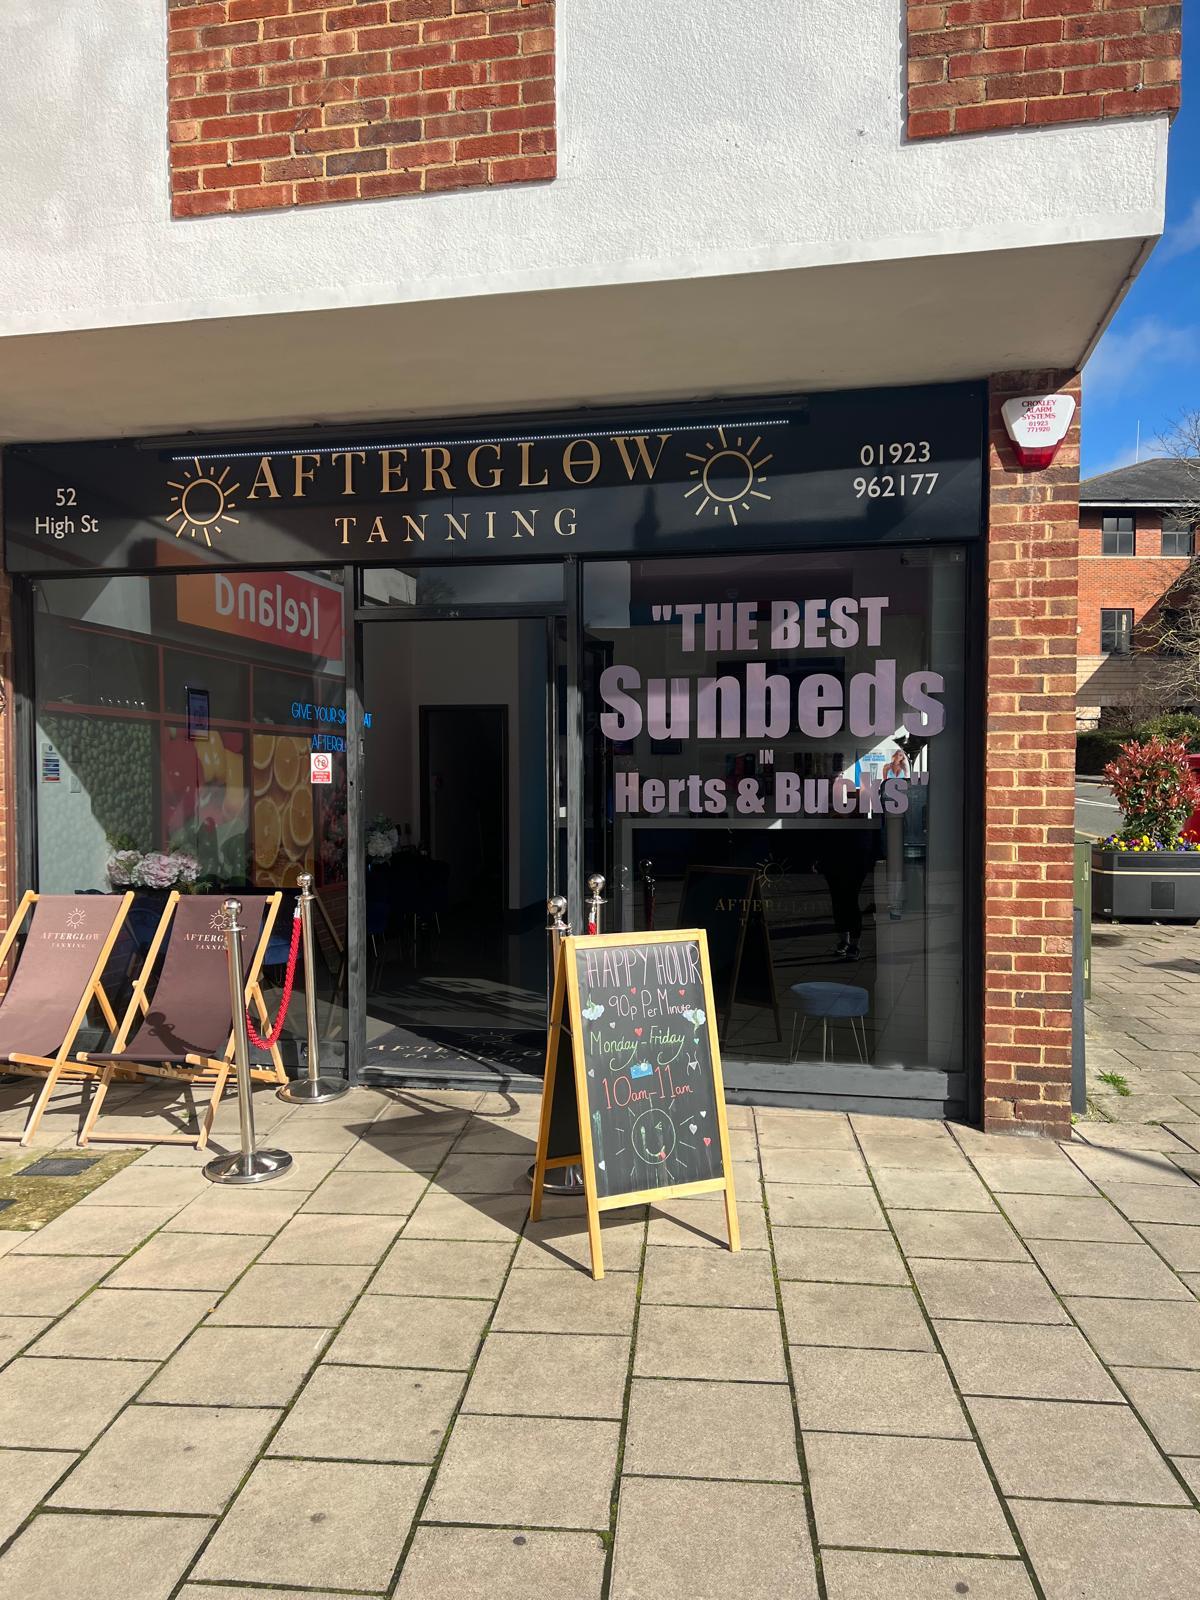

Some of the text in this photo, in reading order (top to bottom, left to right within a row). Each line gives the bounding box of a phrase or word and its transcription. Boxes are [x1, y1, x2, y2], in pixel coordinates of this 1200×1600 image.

[860, 441, 931, 466] 01923
[246, 434, 673, 499] AFTERGLOW
[55, 487, 77, 506] 52
[853, 473, 939, 498] 962177
[35, 514, 99, 539] High St
[334, 508, 577, 544] TANNING
[652, 597, 889, 652] "THE BEST
[291, 702, 312, 720] GIVE
[314, 705, 337, 722] YOUR
[600, 659, 945, 740] Sunbeds
[311, 734, 347, 752] AFTERGL
[759, 749, 774, 764] IN
[615, 773, 727, 813] Herts
[736, 778, 765, 813] &
[40, 932, 101, 941] AFTERGLOW
[184, 933, 247, 942] AFTERG
[586, 943, 703, 988] HAPPY HOUR
[608, 988, 692, 1021] 90p Per Minute
[590, 1030, 639, 1071] Monday
[650, 1025, 685, 1065] Friday
